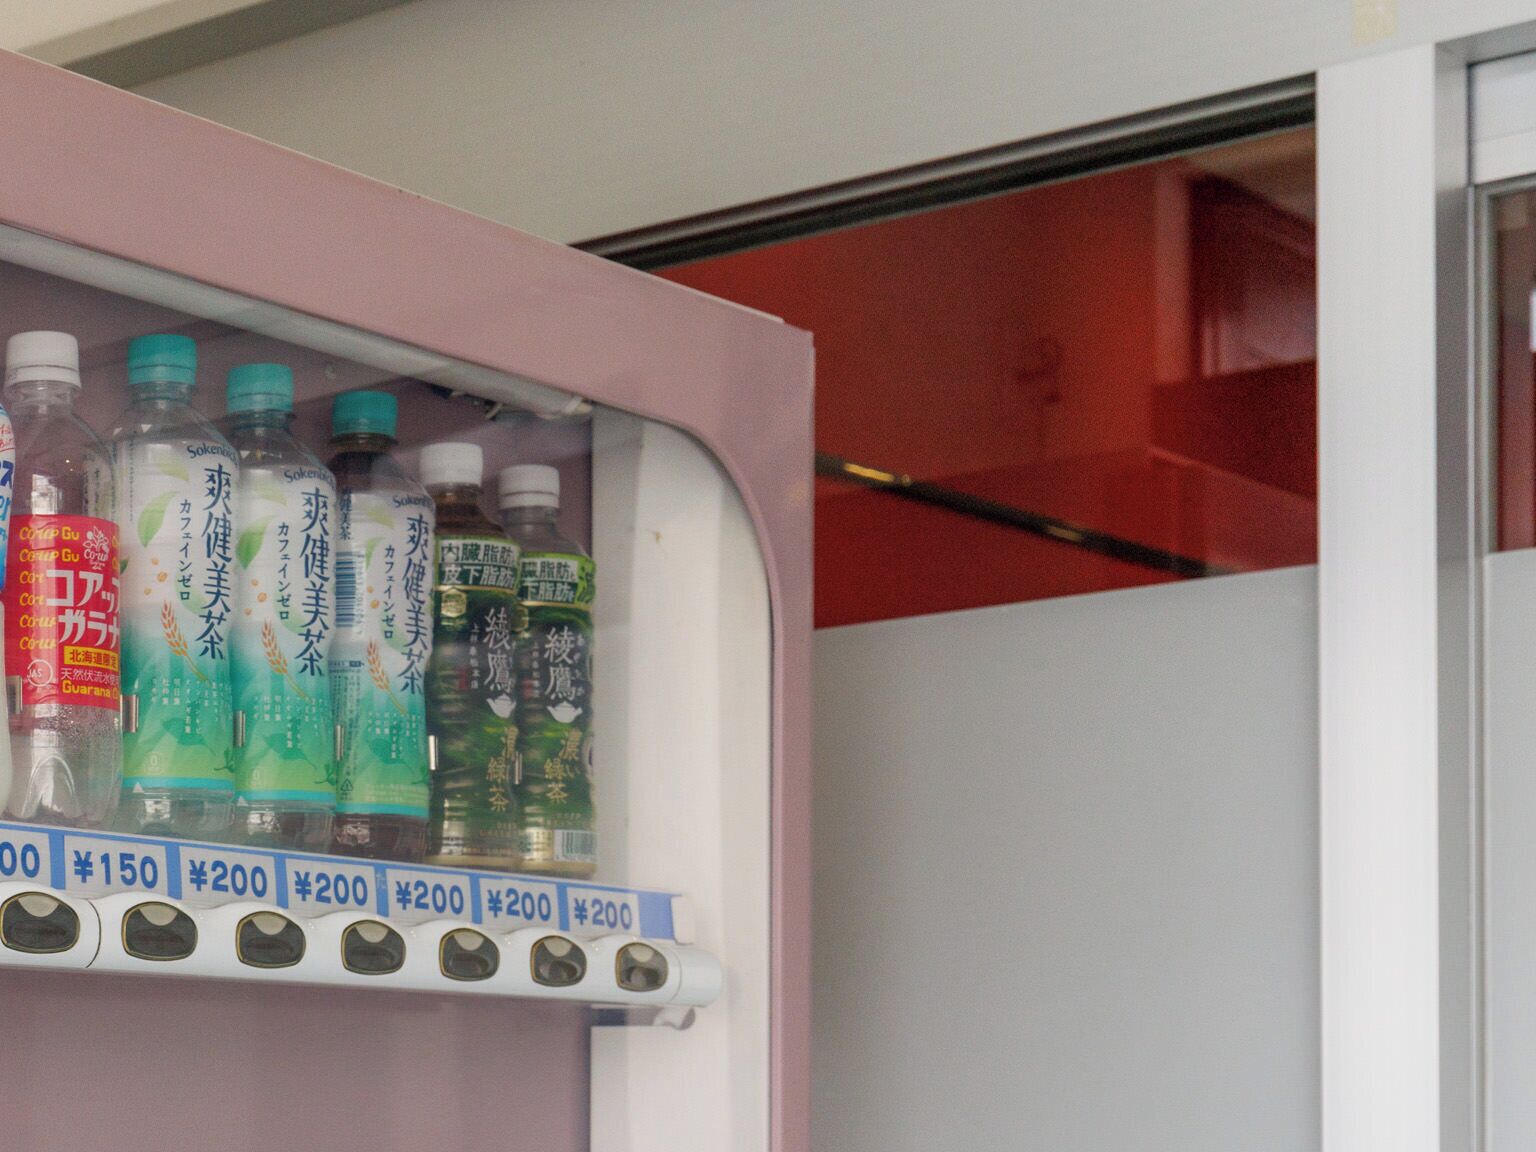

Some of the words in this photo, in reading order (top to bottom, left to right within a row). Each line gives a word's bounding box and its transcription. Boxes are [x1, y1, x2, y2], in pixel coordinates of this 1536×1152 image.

[178, 498, 193, 600] カフェインゼロ
[195, 464, 232, 660] 爽健美茶
[277, 521, 291, 620] カフェインゼロ
[294, 487, 330, 677] 爽健美茶
[383, 544, 396, 640] カフェインゼロ
[398, 514, 429, 695] 爽健美茶
[485, 607, 512, 693] 綾鷹
[544, 626, 577, 701] 綾鷹
[62, 680, 111, 698] Guarana
[486, 758, 510, 812] 緑茶
[543, 757, 568, 803] 緑茶
[73, 849, 159, 889] ¥150
[189, 859, 267, 898] ¥200
[295, 871, 369, 906] ¥200
[396, 880, 464, 916] ¥200
[487, 886, 552, 922] ¥200
[573, 898, 633, 930] ¥200
